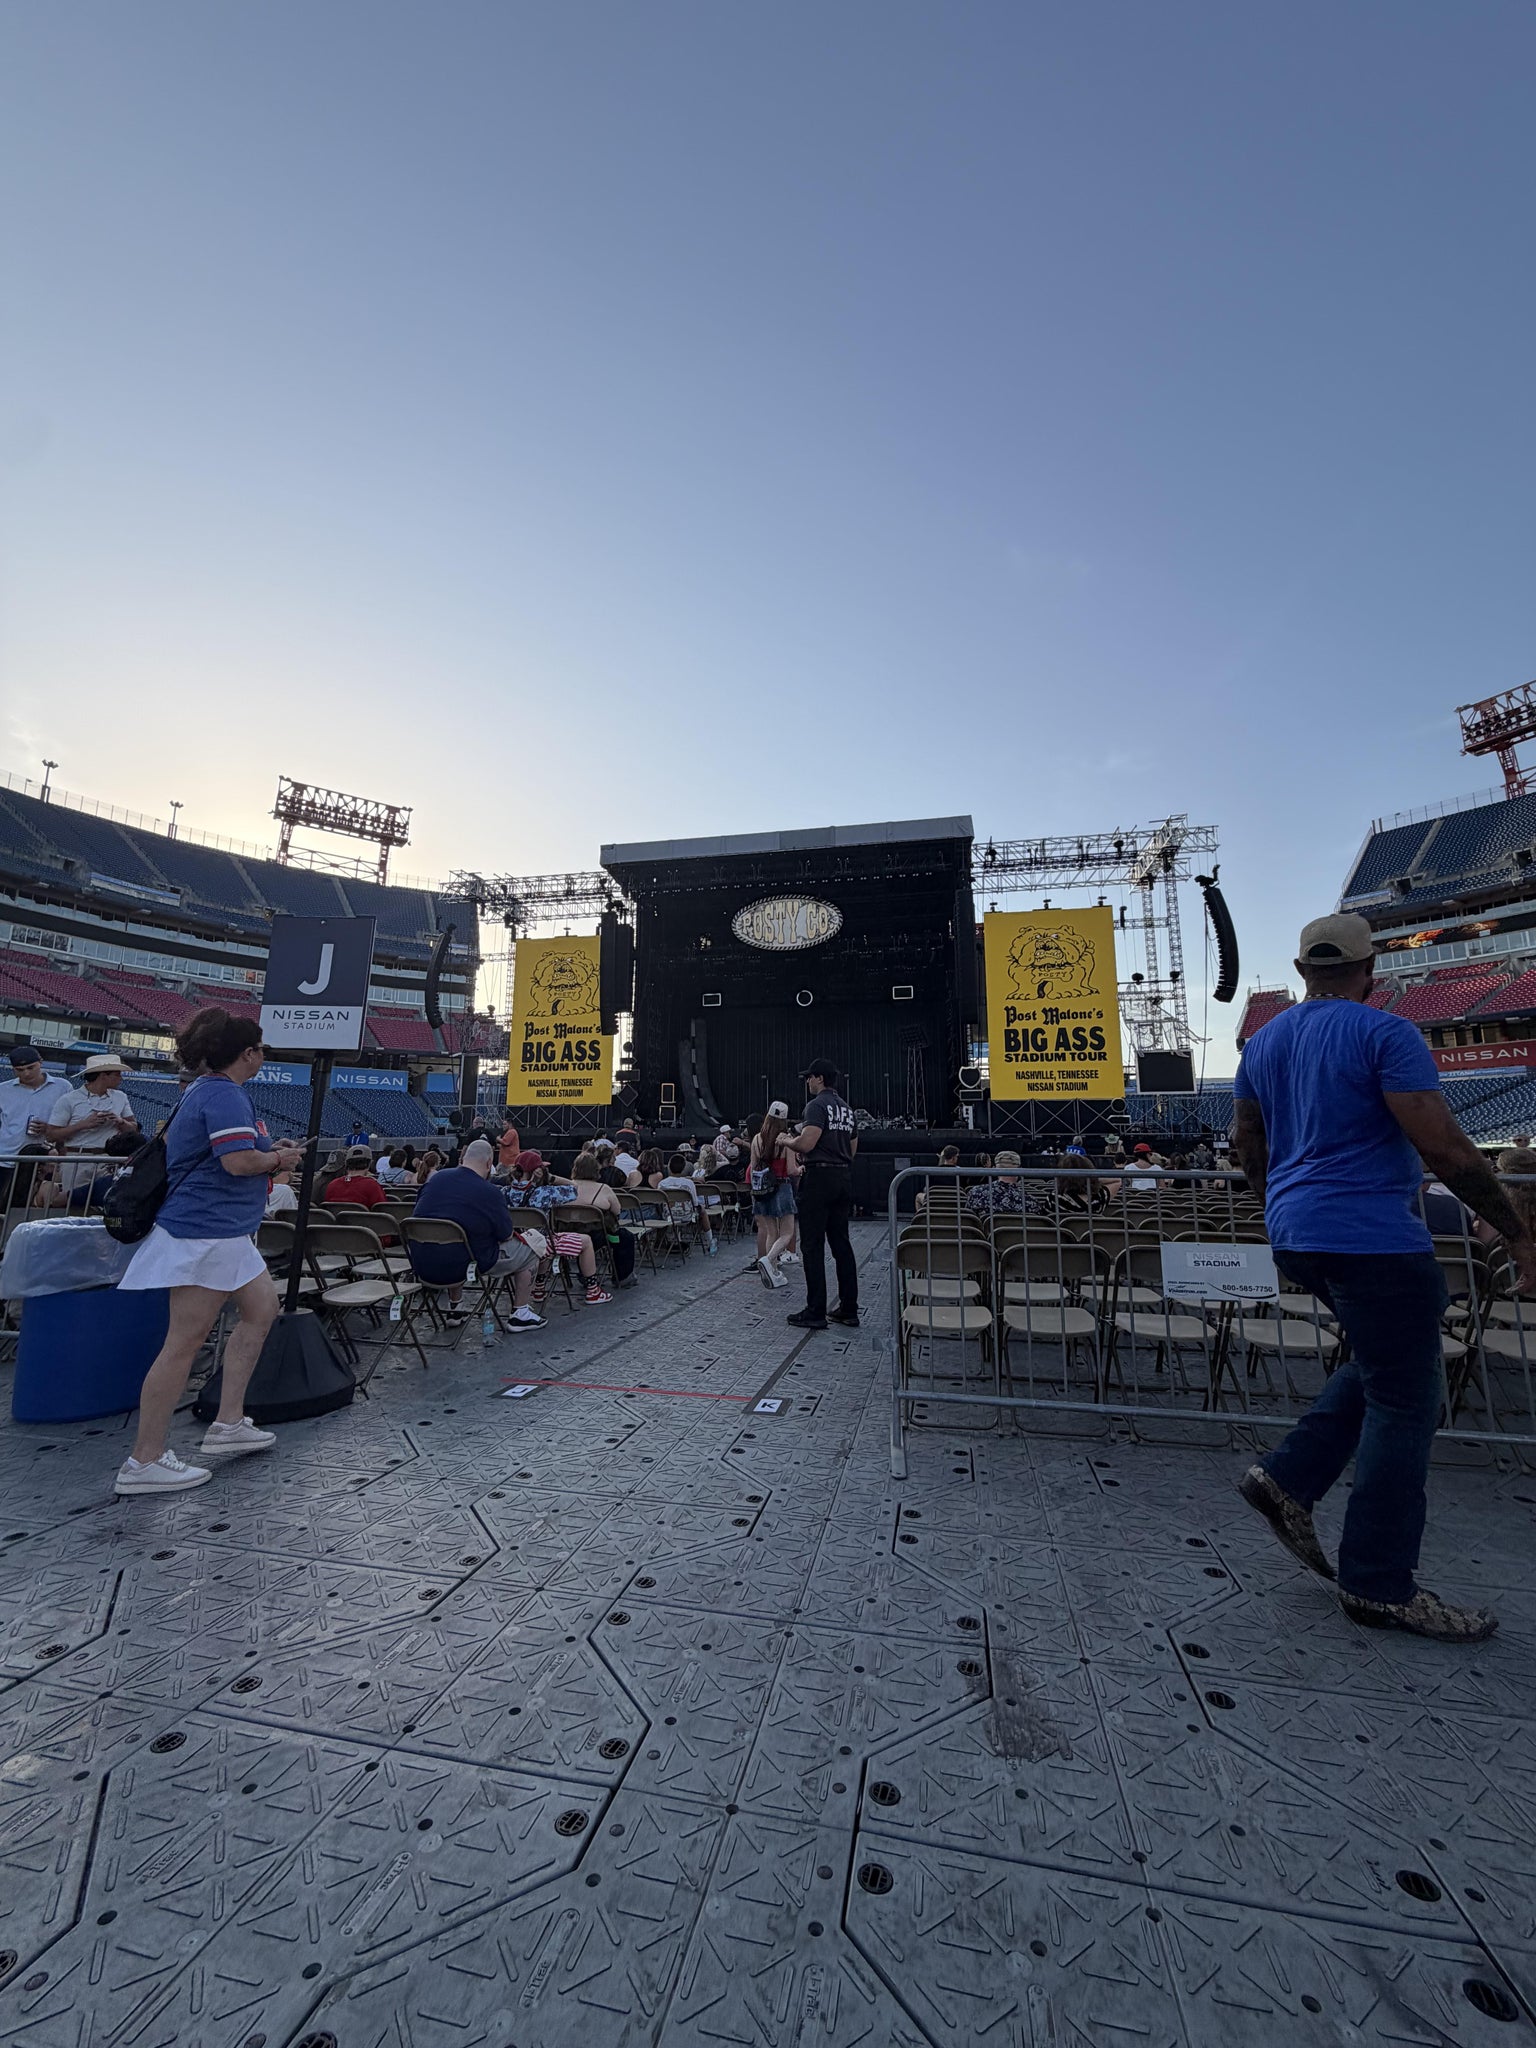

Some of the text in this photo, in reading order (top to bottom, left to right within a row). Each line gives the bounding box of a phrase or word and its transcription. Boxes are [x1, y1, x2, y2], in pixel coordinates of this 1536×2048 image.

[742, 901, 828, 944] POSTY CO
[297, 944, 334, 995] J
[272, 1010, 349, 1021] NISSAN
[1004, 1006, 1103, 1027] Post Malone's
[283, 1022, 335, 1030] STADIUM
[524, 1022, 601, 1041] Post Malone's
[31, 1038, 65, 1048] Pinnacle
[1004, 1026, 1106, 1053] BIG ASS
[521, 1040, 601, 1063] BIG ASS
[1004, 1051, 1108, 1063] STADIUM TOUR
[1441, 1047, 1528, 1063] NISSAN
[520, 1062, 601, 1072] STADIUM TOUR
[336, 1074, 404, 1086] NISSAN
[1015, 1070, 1099, 1081] NASHVILLE, TENNESSEE
[528, 1078, 593, 1088] NASHVILLE, TENNESSEE
[1027, 1082, 1088, 1091] NISSAN STADIUM
[536, 1089, 583, 1098] NISSAN STADIUM
[1192, 1252, 1240, 1260] NISSAN
[1222, 1284, 1273, 1292] 800-585-7750
